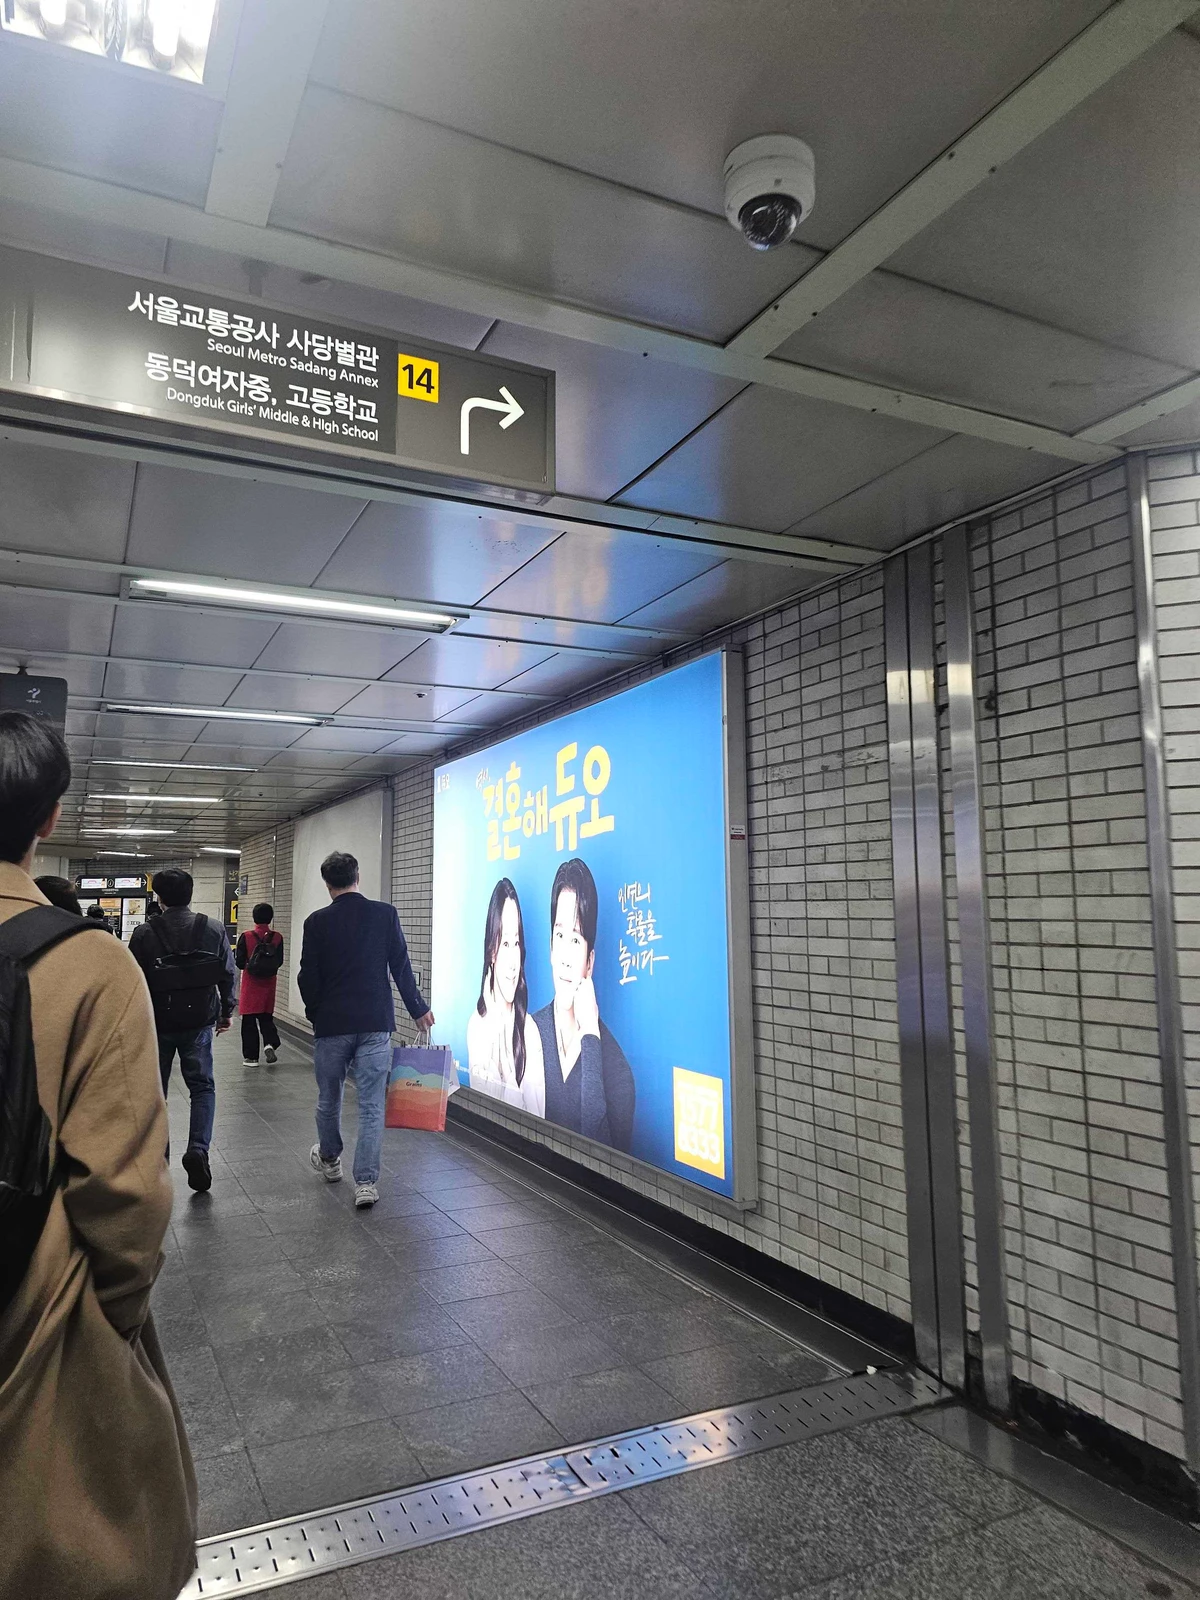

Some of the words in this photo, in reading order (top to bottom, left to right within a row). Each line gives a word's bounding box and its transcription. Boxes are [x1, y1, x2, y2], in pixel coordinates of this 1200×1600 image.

[127, 290, 281, 350] 서울교통공사
[286, 328, 380, 373] 사당별관
[144, 351, 278, 406] 동덕여자중,
[285, 383, 379, 424] 고등학교
[207, 338, 245, 358] Seoul
[247, 346, 288, 368] Metro
[289, 356, 337, 381] Sadang
[339, 368, 379, 389] Annex
[402, 363, 435, 394] 14
[167, 386, 225, 410] Dongduk
[258, 405, 300, 426] Middle
[301, 413, 311, 428] &
[341, 423, 379, 442] School
